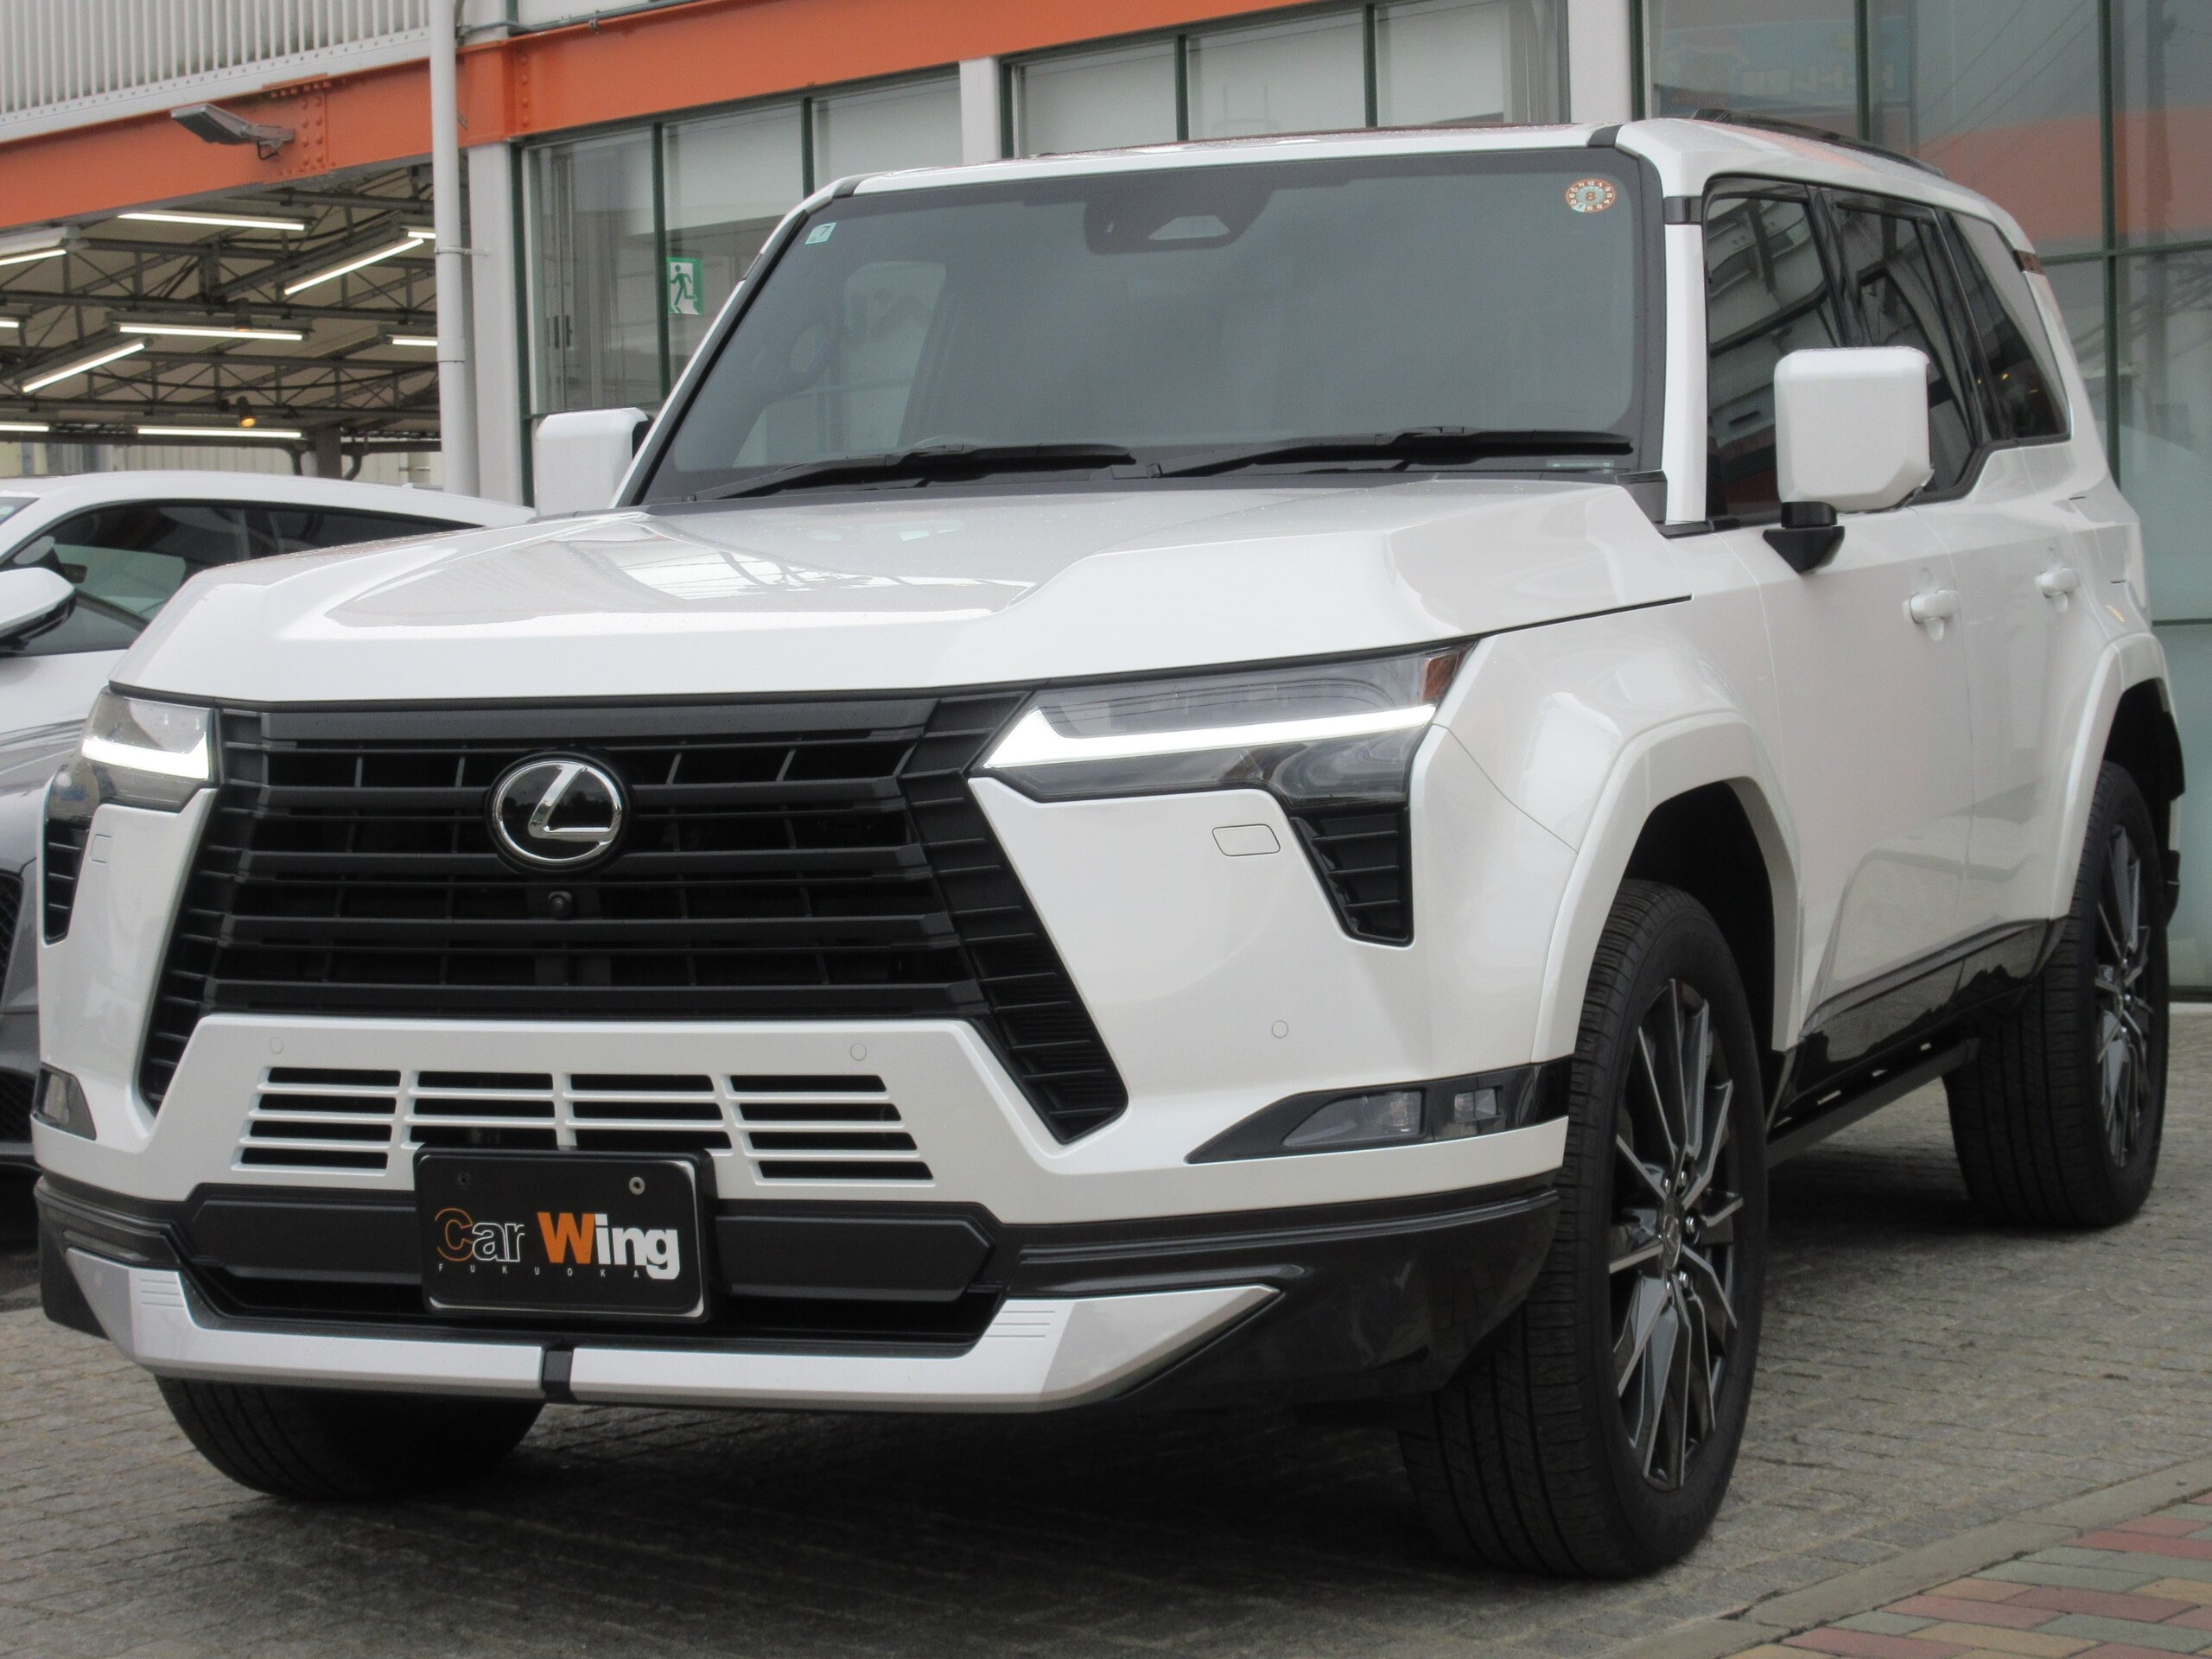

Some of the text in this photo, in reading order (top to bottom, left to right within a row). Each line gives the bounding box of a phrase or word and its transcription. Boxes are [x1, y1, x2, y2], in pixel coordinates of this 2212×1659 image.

[1585, 192, 1596, 201] 8
[435, 1208, 680, 1280] Car Wing
[439, 1263, 639, 1279] FUKUOKA
